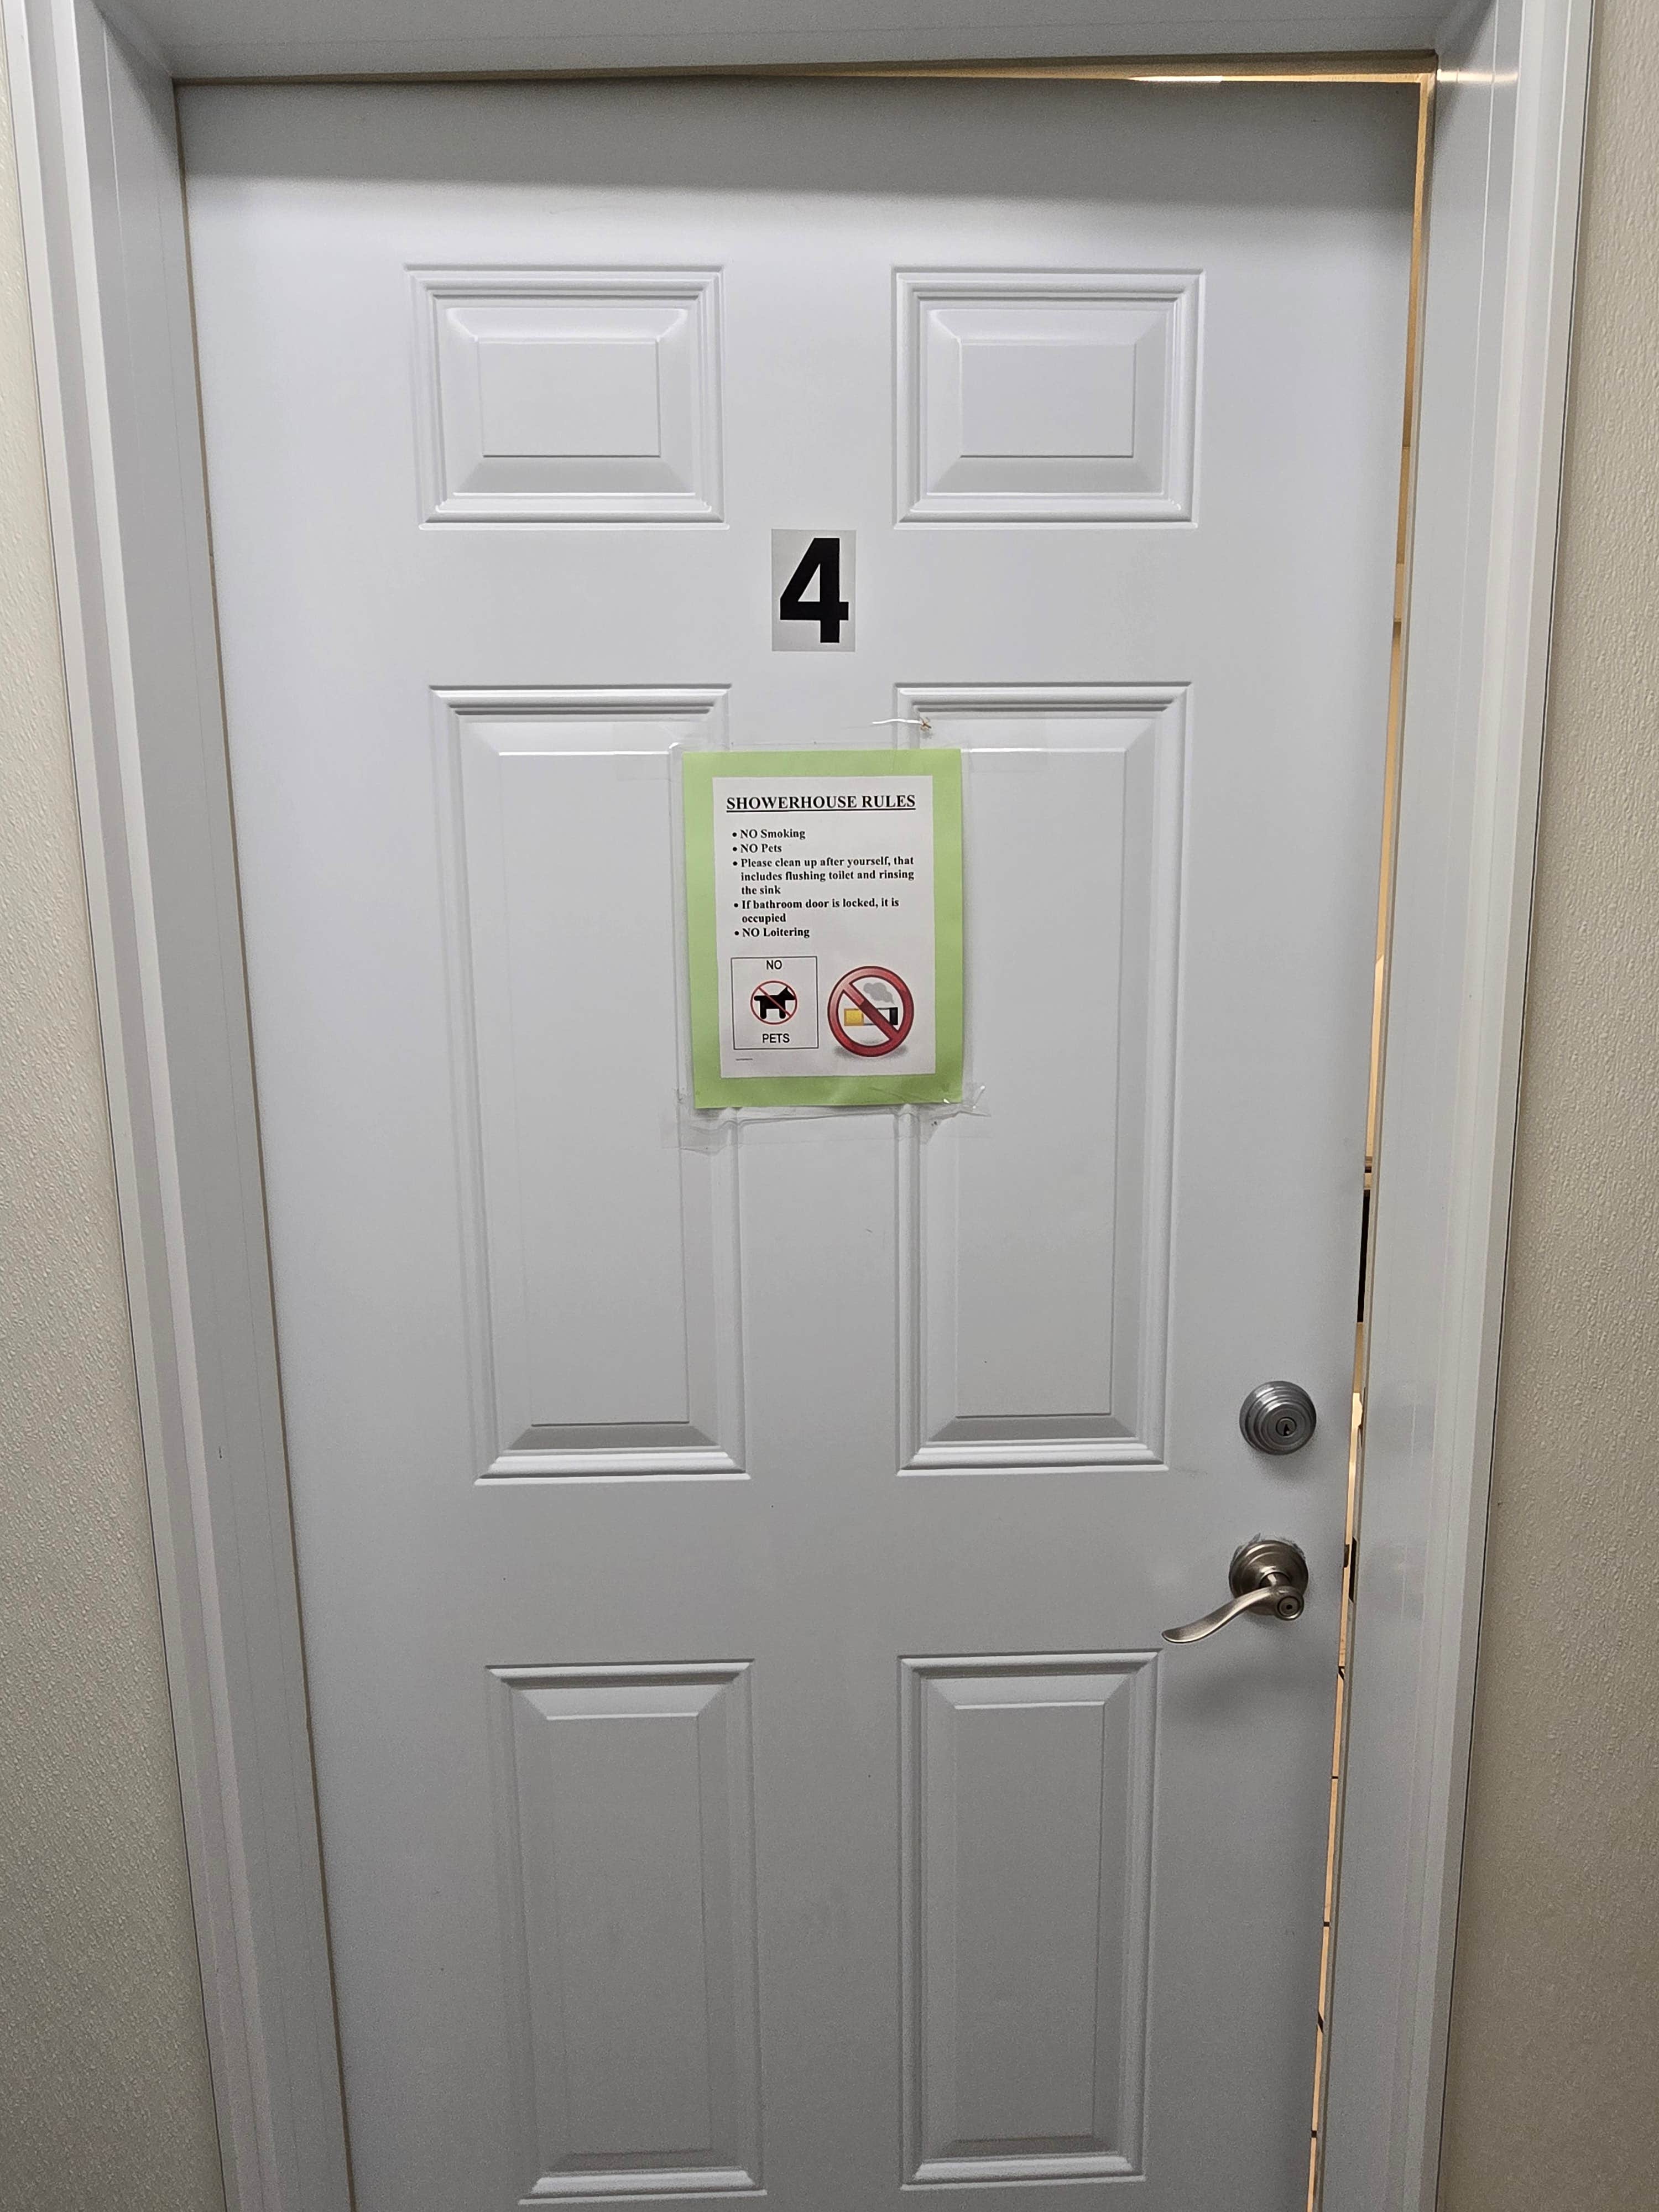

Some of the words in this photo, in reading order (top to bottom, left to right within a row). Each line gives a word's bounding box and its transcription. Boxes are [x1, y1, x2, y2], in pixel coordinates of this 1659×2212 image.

[780, 538, 849, 643] 4
[726, 795, 857, 810] SHOWERHOUSE
[862, 794, 916, 808] RULES
[740, 829, 758, 838] NO
[760, 828, 806, 839] Smoking
[740, 843, 758, 853] NO
[761, 843, 782, 853] Pets
[740, 858, 773, 867] Please
[775, 857, 801, 867] clean
[804, 859, 817, 869] up
[820, 857, 844, 867] after
[847, 856, 891, 868] yourself,
[894, 856, 914, 865] that
[740, 872, 782, 881] includes
[785, 870, 826, 882] flushing
[828, 870, 854, 880] toilet
[857, 870, 875, 879] and
[879, 870, 914, 880] rinsing
[741, 885, 757, 895] the
[759, 885, 781, 894] sink
[742, 900, 752, 909] If
[753, 899, 802, 909] bathroom
[805, 899, 829, 908] door
[832, 898, 839, 907] is
[843, 898, 878, 909] locked,
[881, 898, 888, 907] it
[891, 898, 899, 906] is
[742, 913, 786, 924] occupied
[742, 927, 760, 937] NO
[763, 927, 810, 938] Loitering
[766, 959, 782, 970] NO
[762, 1033, 790, 1044] PETS
